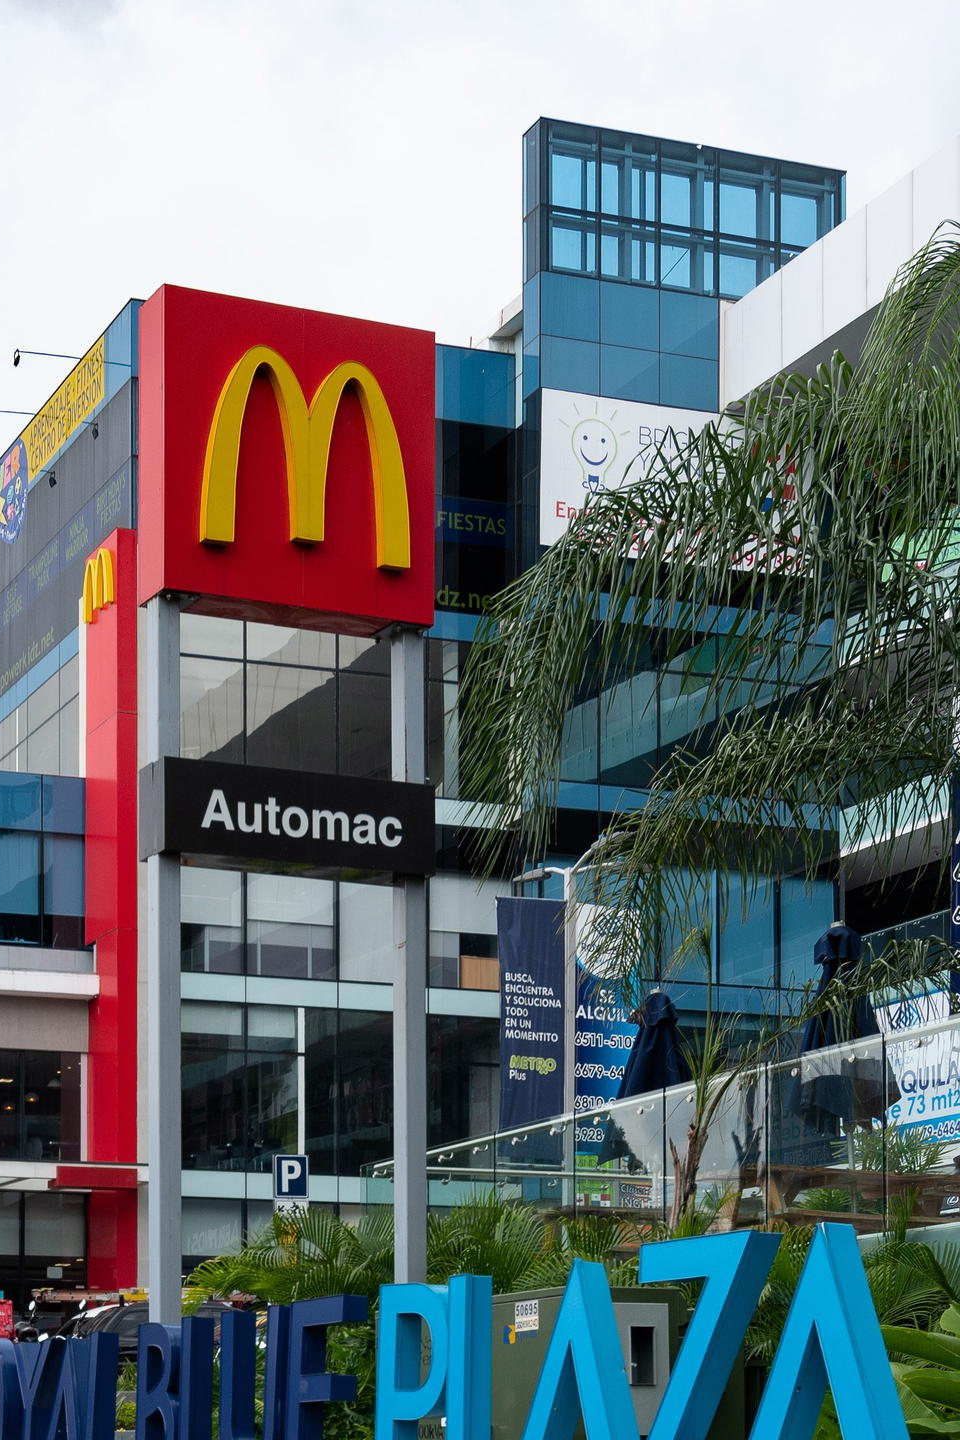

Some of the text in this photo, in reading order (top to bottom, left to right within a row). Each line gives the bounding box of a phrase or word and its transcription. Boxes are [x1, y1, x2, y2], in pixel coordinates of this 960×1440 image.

[30, 427, 56, 473] CENTRO
[57, 415, 66, 441] DE
[436, 510, 506, 536] FIESTAS
[0, 626, 55, 695] powerkidz.net
[200, 788, 404, 848] Automac
[505, 972, 535, 985] BUSCA,
[505, 984, 554, 997] ENCUENTRA
[505, 995, 562, 1009] Y SOLUCIONA
[505, 1007, 529, 1018] TODO
[575, 1004, 637, 1023] ALQUIL
[505, 1018, 532, 1029] EN UN
[505, 1030, 559, 1043] MOMENTITO
[574, 1031, 637, 1049] 6511-510
[509, 1054, 557, 1075] METRO
[509, 1070, 527, 1081] Plus
[907, 1093, 926, 1116] 73
[515, 1302, 538, 1317] 50695
